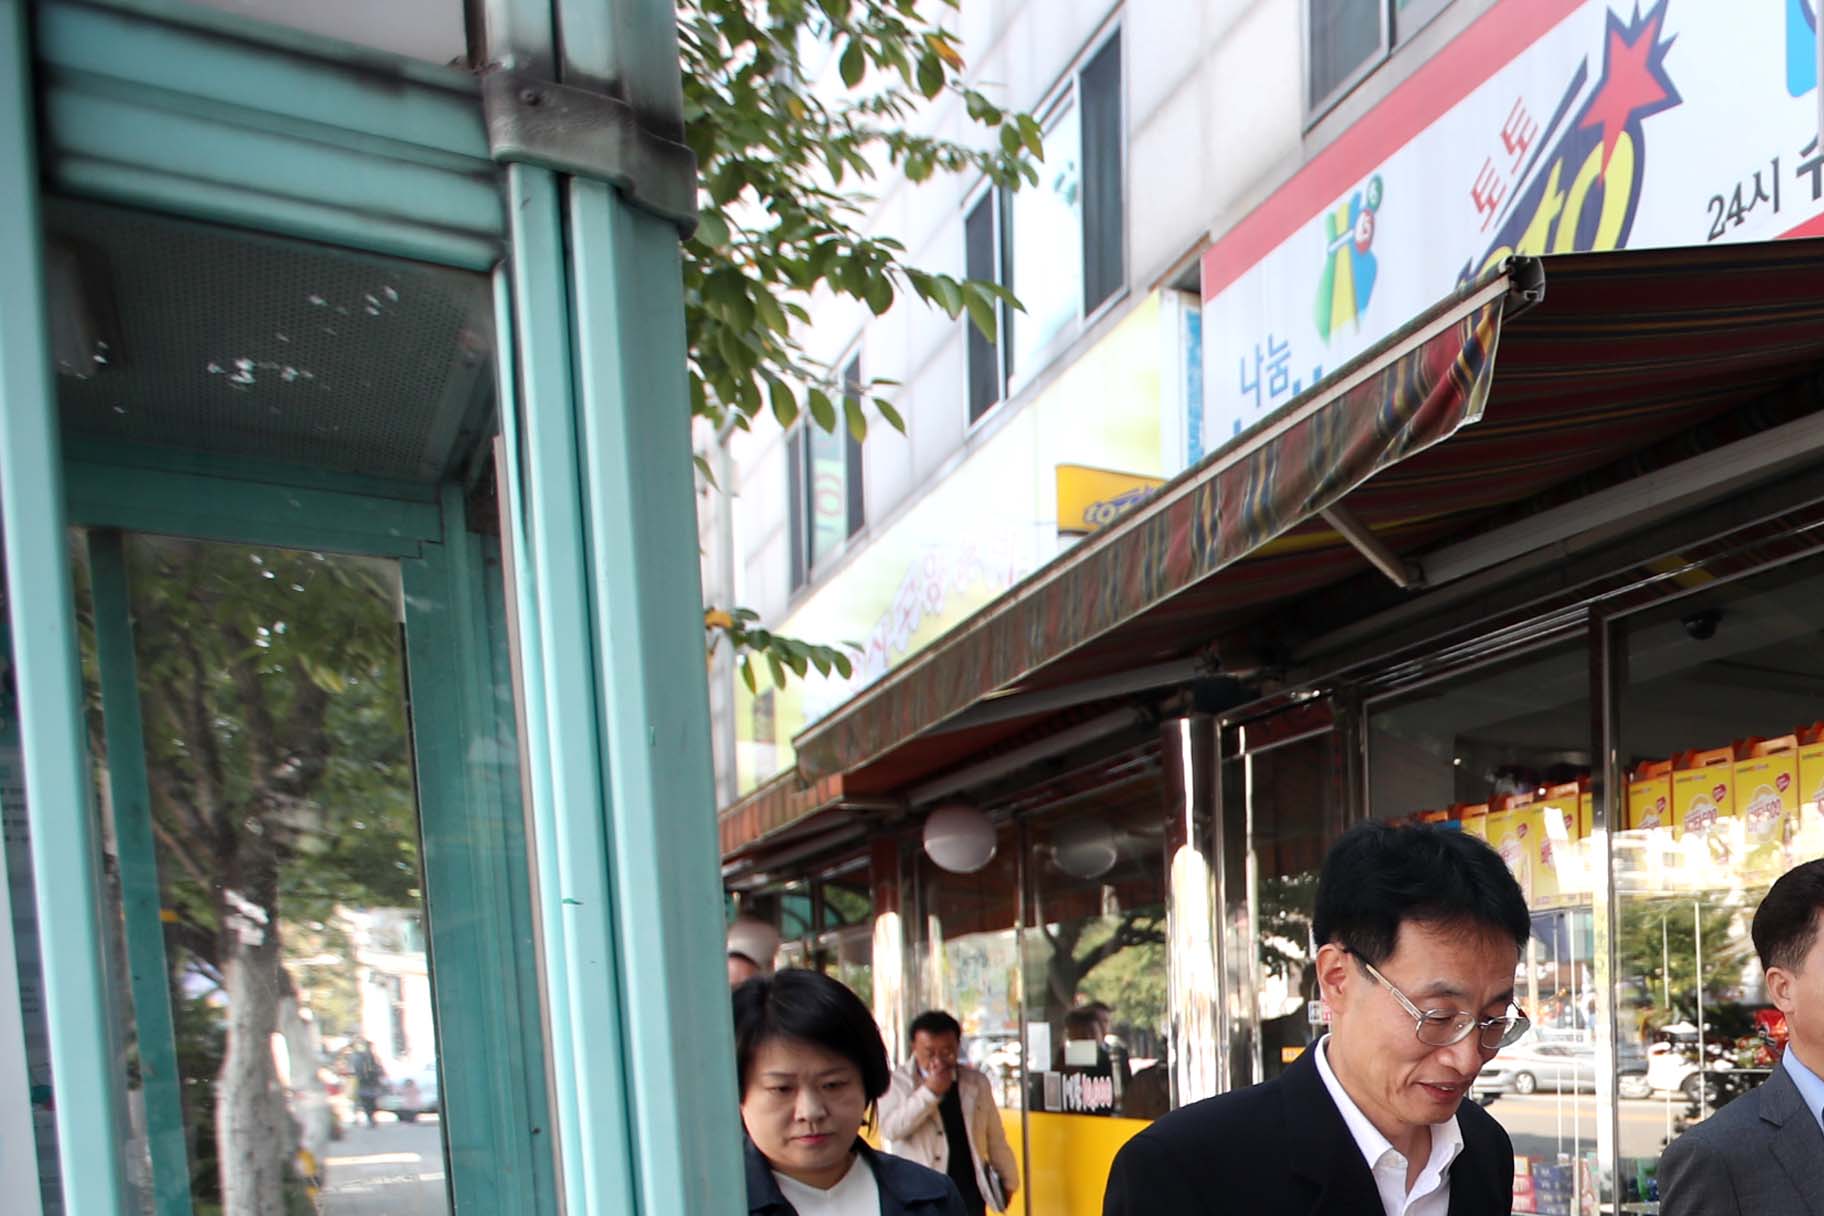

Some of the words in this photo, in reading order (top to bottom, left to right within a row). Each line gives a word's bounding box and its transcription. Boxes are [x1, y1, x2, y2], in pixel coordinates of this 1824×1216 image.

[1470, 96, 1539, 233] 토토
[1706, 156, 1780, 242] 24시
[1240, 334, 1290, 408] 나눔
